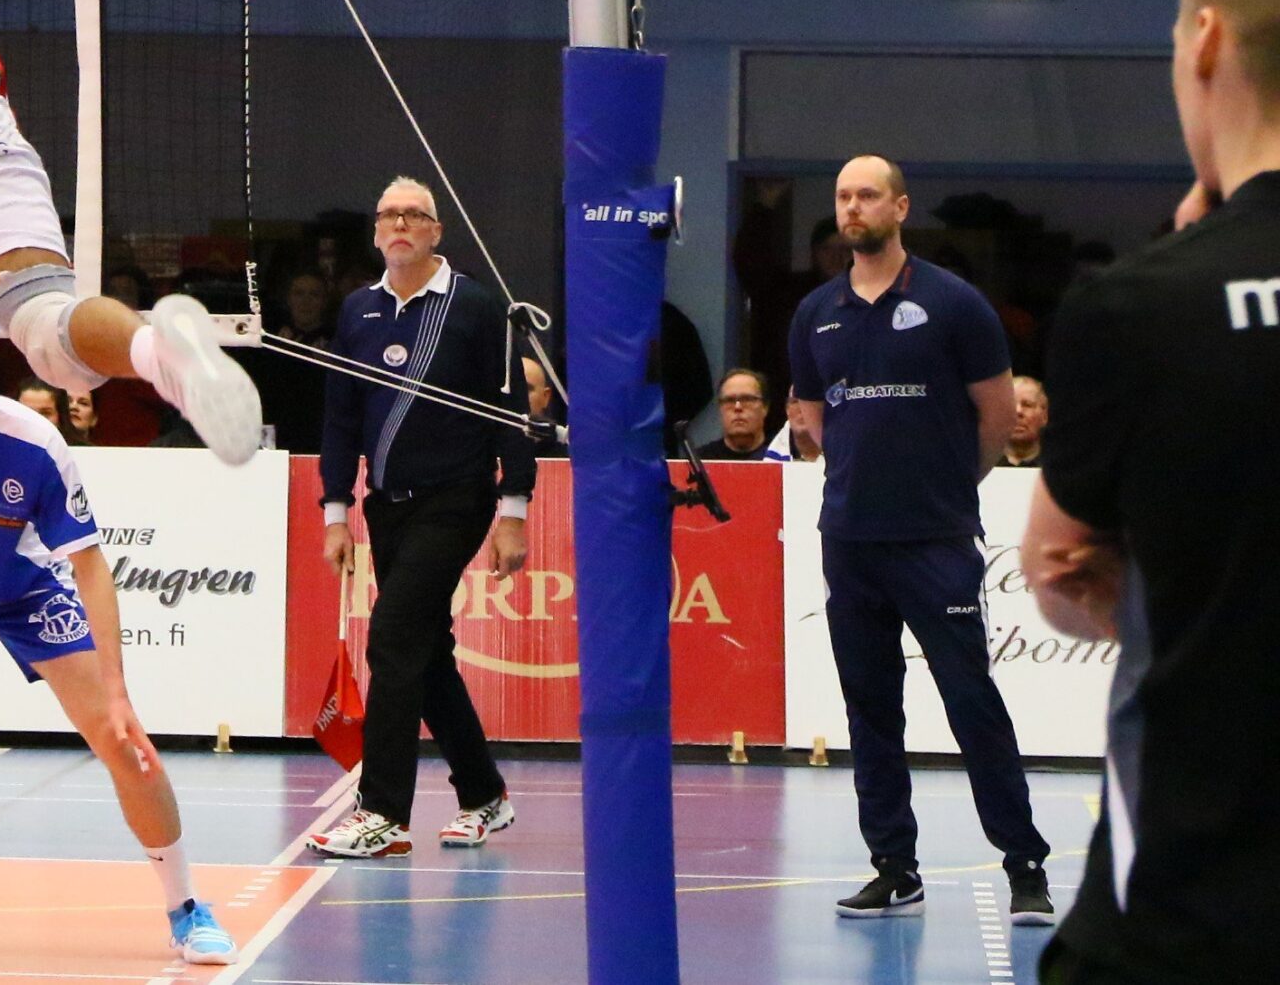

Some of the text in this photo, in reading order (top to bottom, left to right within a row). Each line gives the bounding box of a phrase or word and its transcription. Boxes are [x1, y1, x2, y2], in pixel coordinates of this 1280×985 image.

[584, 205, 610, 221] all
[614, 206, 634, 222] in
[845, 384, 928, 401] MEGATREX
[111, 555, 256, 608] lmgren
